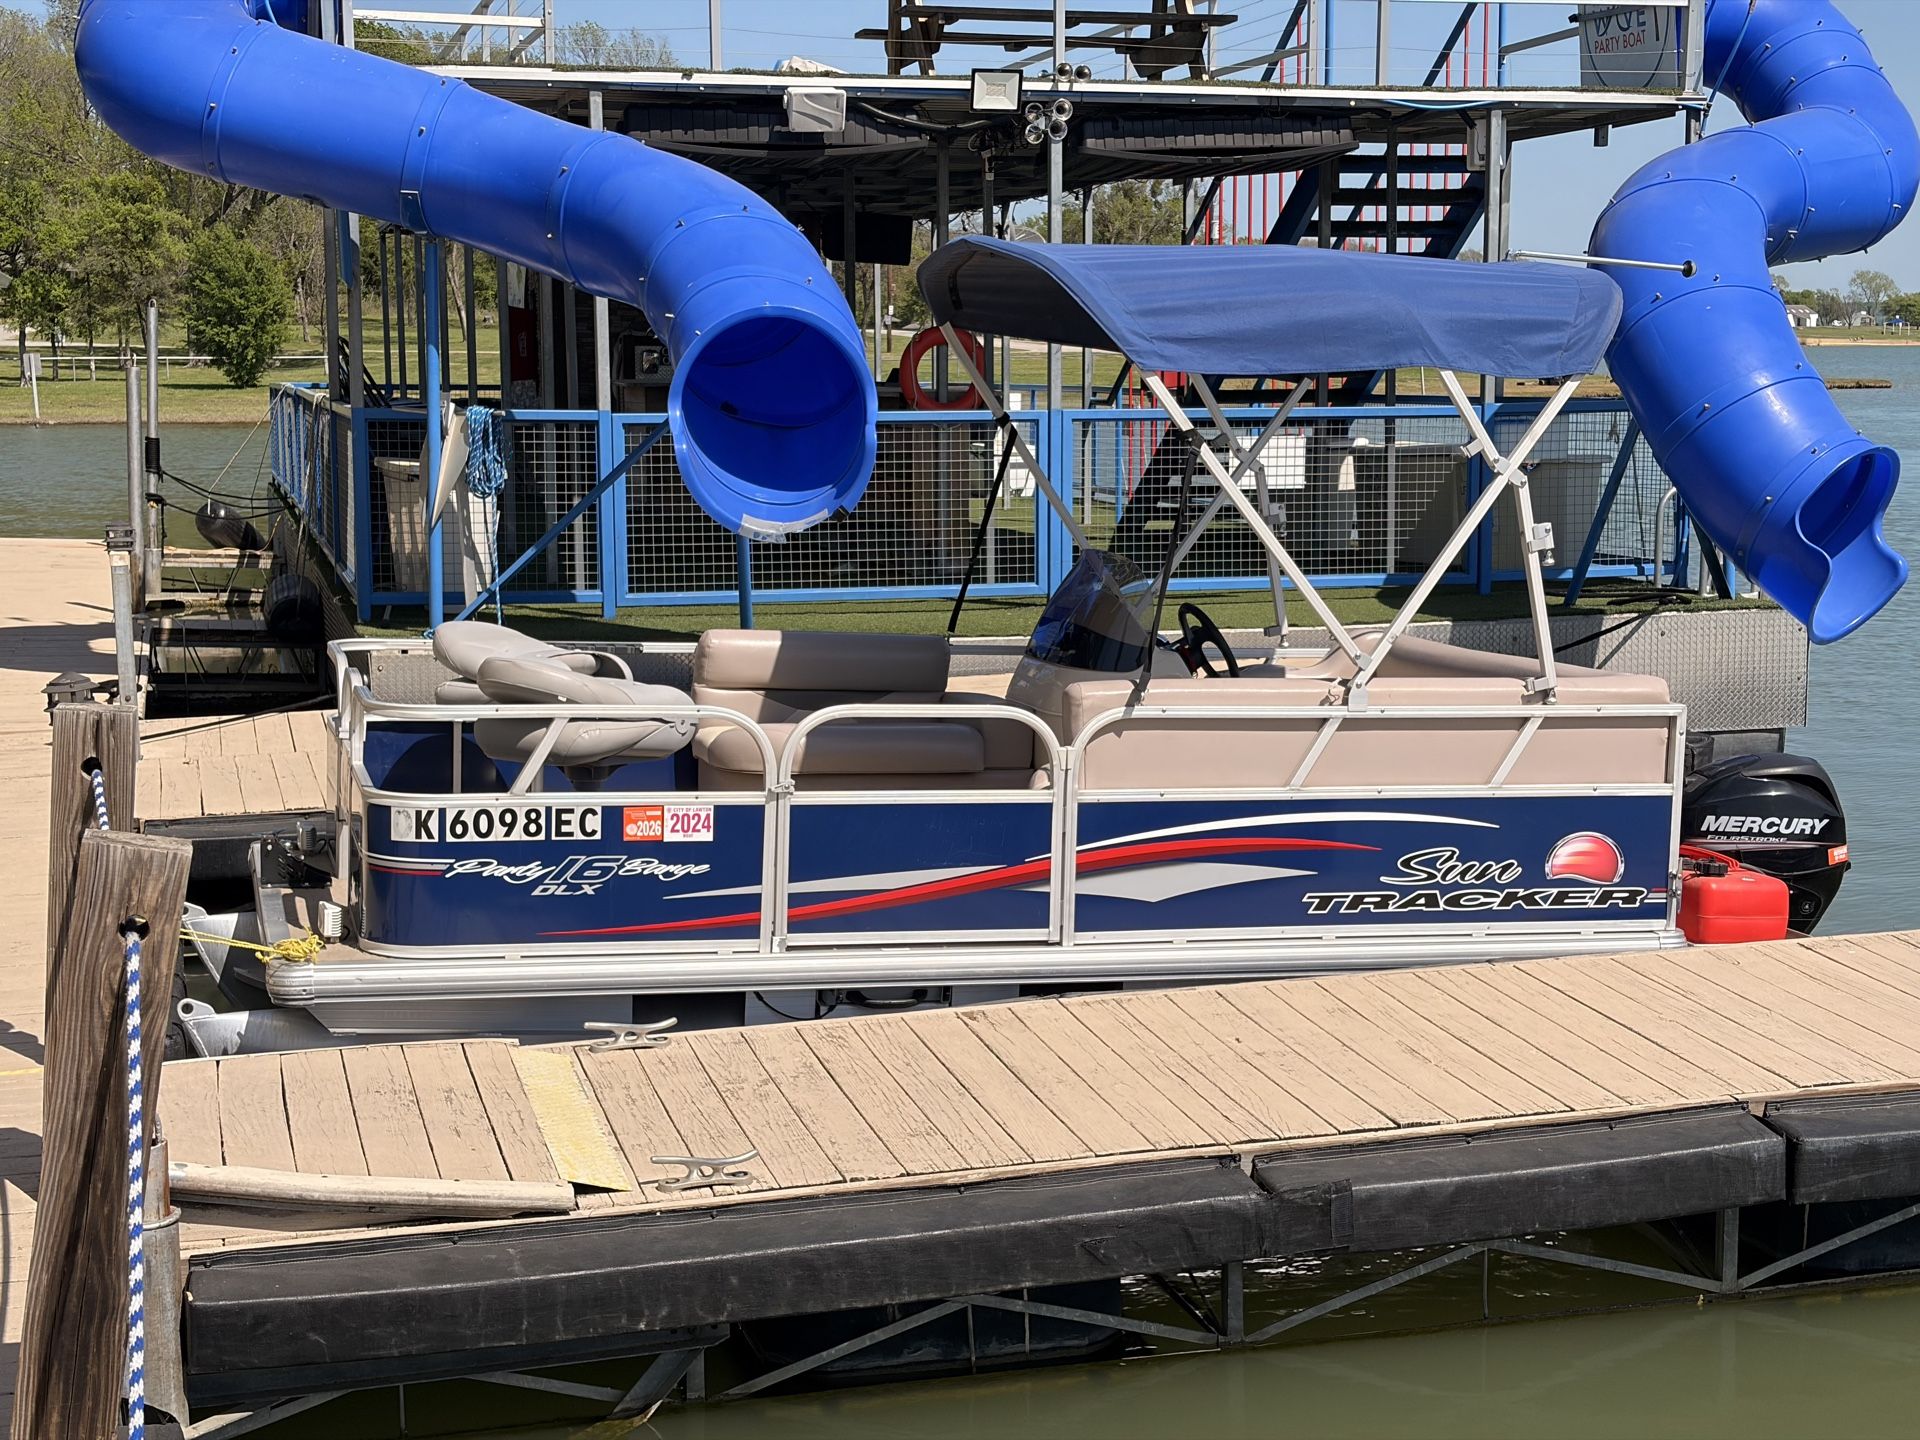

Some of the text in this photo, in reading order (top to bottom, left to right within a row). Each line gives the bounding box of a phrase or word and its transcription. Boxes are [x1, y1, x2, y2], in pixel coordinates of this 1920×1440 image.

[1594, 30, 1646, 54] PARTY BOAT
[449, 807, 543, 839] 6098
[554, 806, 599, 838] EC
[636, 820, 662, 836] 2026
[670, 812, 712, 834] 2024
[1700, 815, 1830, 835] MERCURY
[444, 855, 712, 885] Party 16 Barge
[1379, 847, 1523, 886] Sun
[531, 884, 604, 896] DLX
[1302, 887, 1648, 915] TRACKER
